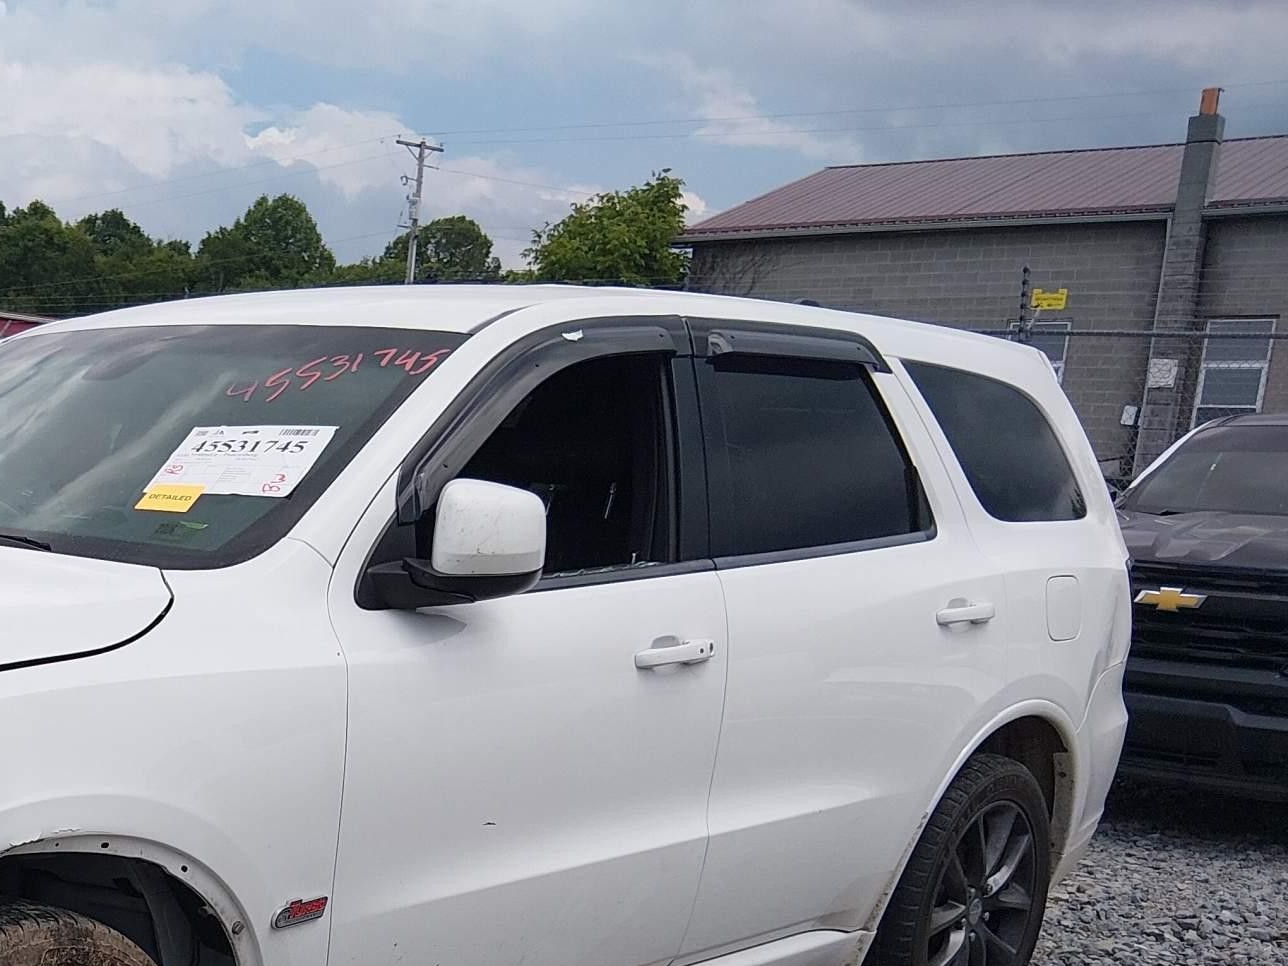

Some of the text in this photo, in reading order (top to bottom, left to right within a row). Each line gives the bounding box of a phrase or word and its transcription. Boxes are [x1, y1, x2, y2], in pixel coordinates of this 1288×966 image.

[227, 348, 451, 402] 45531745
[191, 439, 309, 454] 45531745
[148, 493, 193, 502] DETAILED
